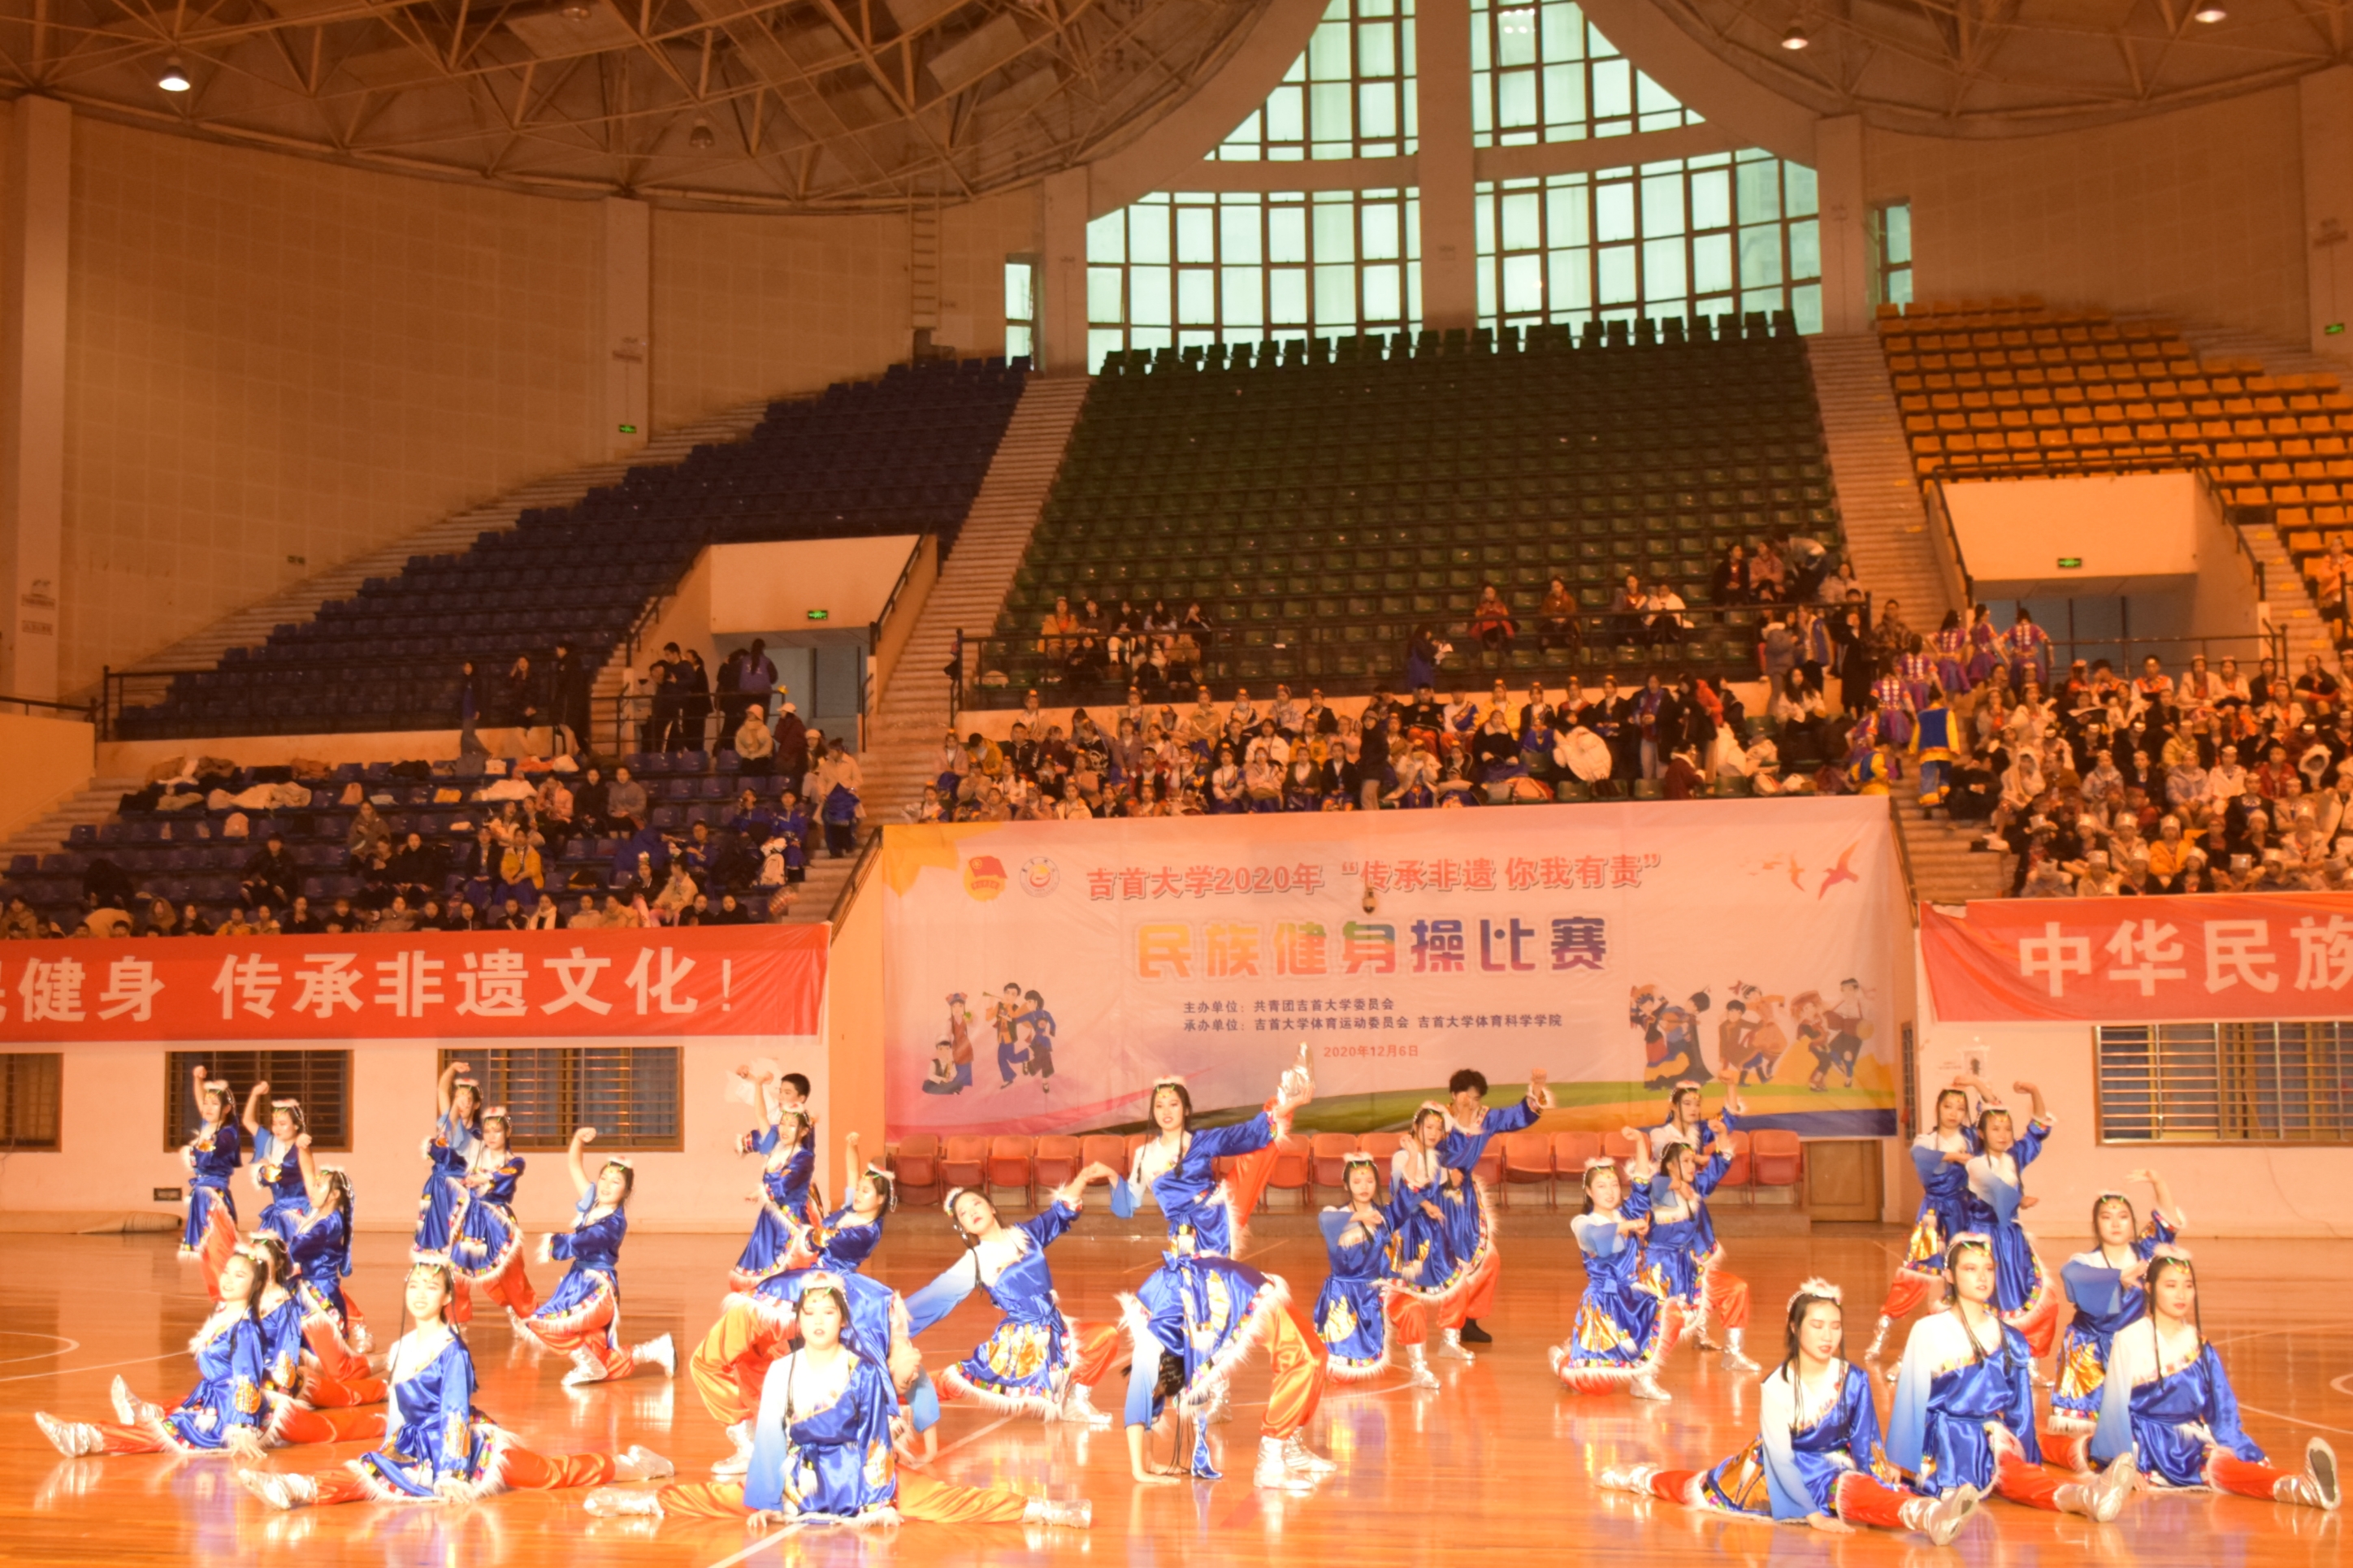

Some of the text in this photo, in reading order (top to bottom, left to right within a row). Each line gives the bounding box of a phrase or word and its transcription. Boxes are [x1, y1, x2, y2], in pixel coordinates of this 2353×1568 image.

[1138, 916, 1606, 977] 民族健身操比赛
[2018, 915, 2353, 998] 中华民族
[0, 955, 166, 1023] 健身
[1324, 1045, 1419, 1059] 2020年12月6日
